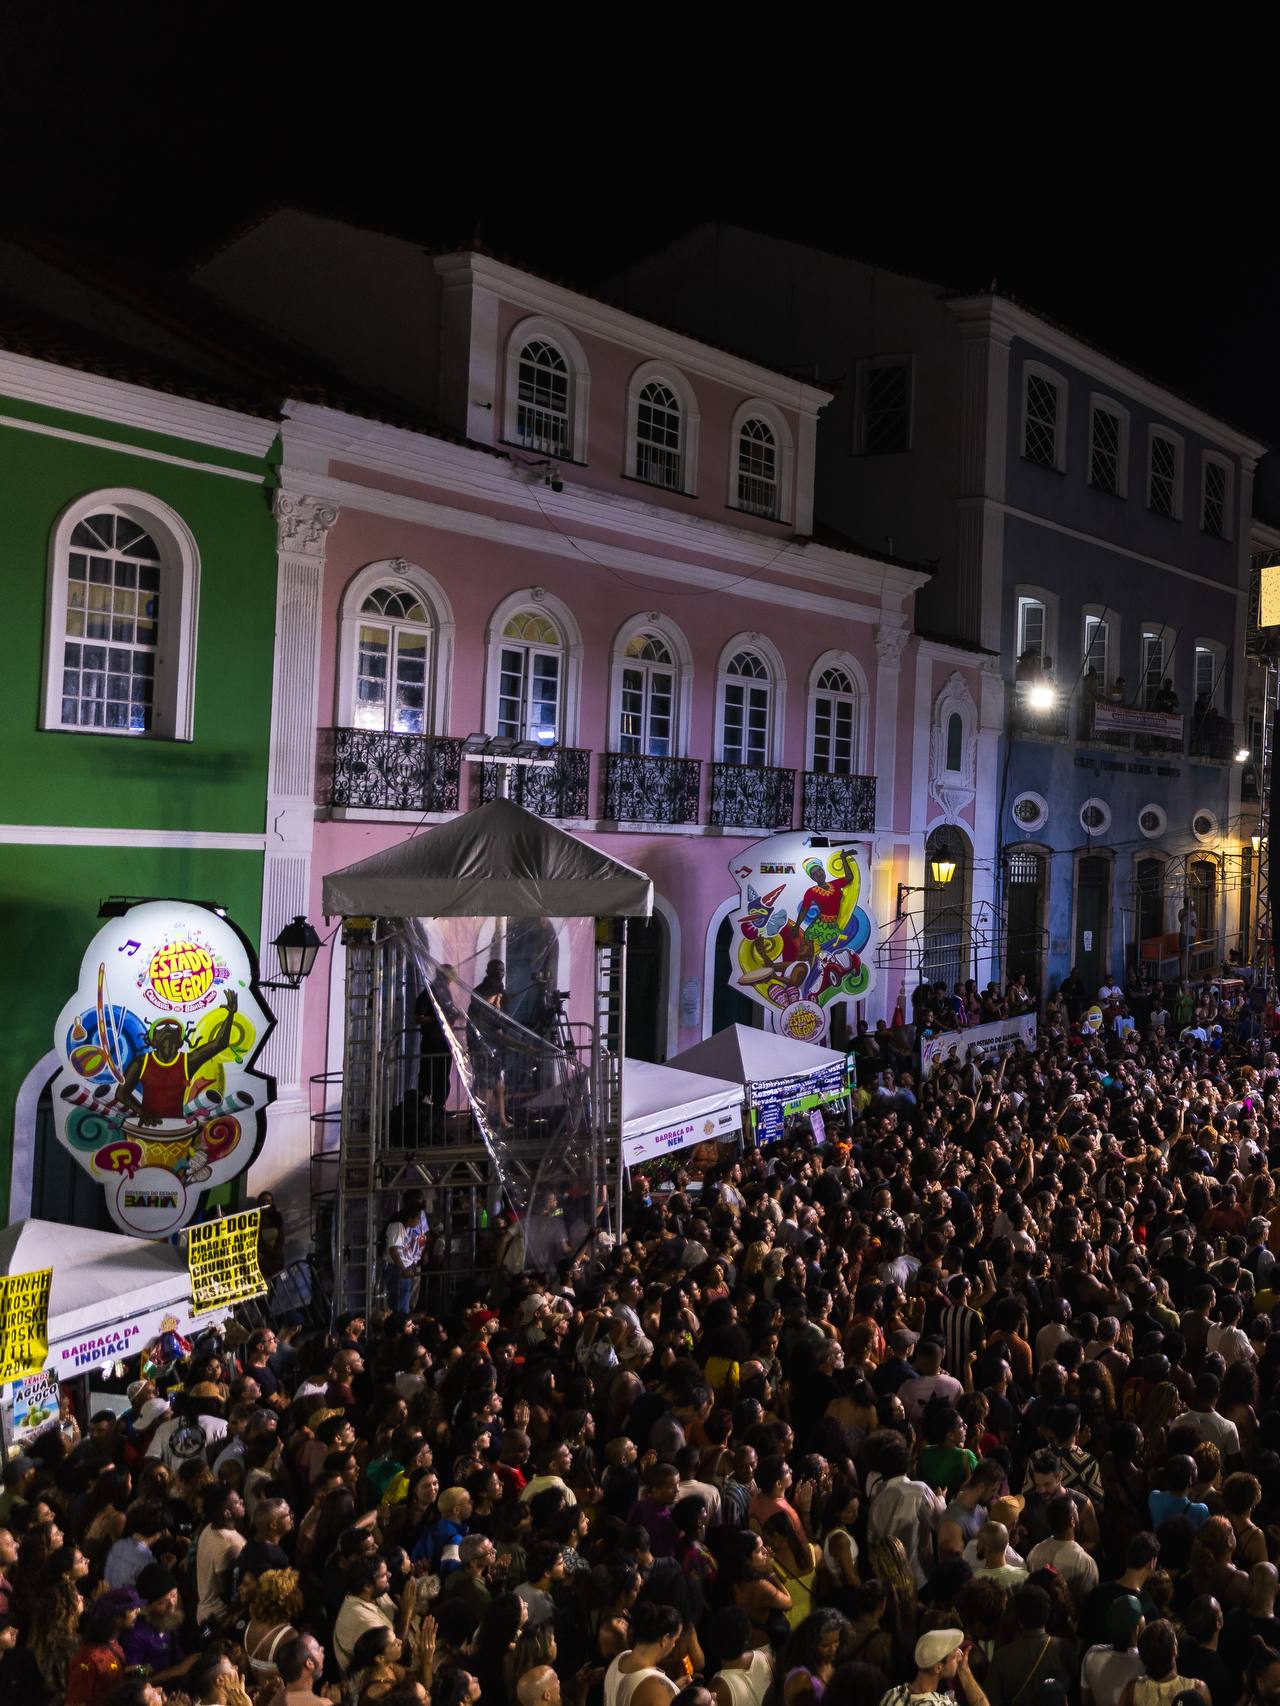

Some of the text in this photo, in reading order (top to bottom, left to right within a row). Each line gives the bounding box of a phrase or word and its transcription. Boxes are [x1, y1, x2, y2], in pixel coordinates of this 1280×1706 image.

[150, 948, 213, 979] ESTADO
[170, 969, 192, 980] DE
[154, 968, 214, 1002] ALEGRIA
[655, 1128, 684, 1143] BARRACA
[686, 1125, 694, 1134] DA
[667, 1136, 684, 1147] NEM
[191, 1212, 258, 1244] HOT-DOG
[222, 1237, 232, 1247] DE
[193, 1250, 256, 1277] CHURRASCO
[62, 1325, 139, 1360] BARRACA DA
[75, 1339, 129, 1367] INDIACI
[28, 1384, 57, 1406] COCO
